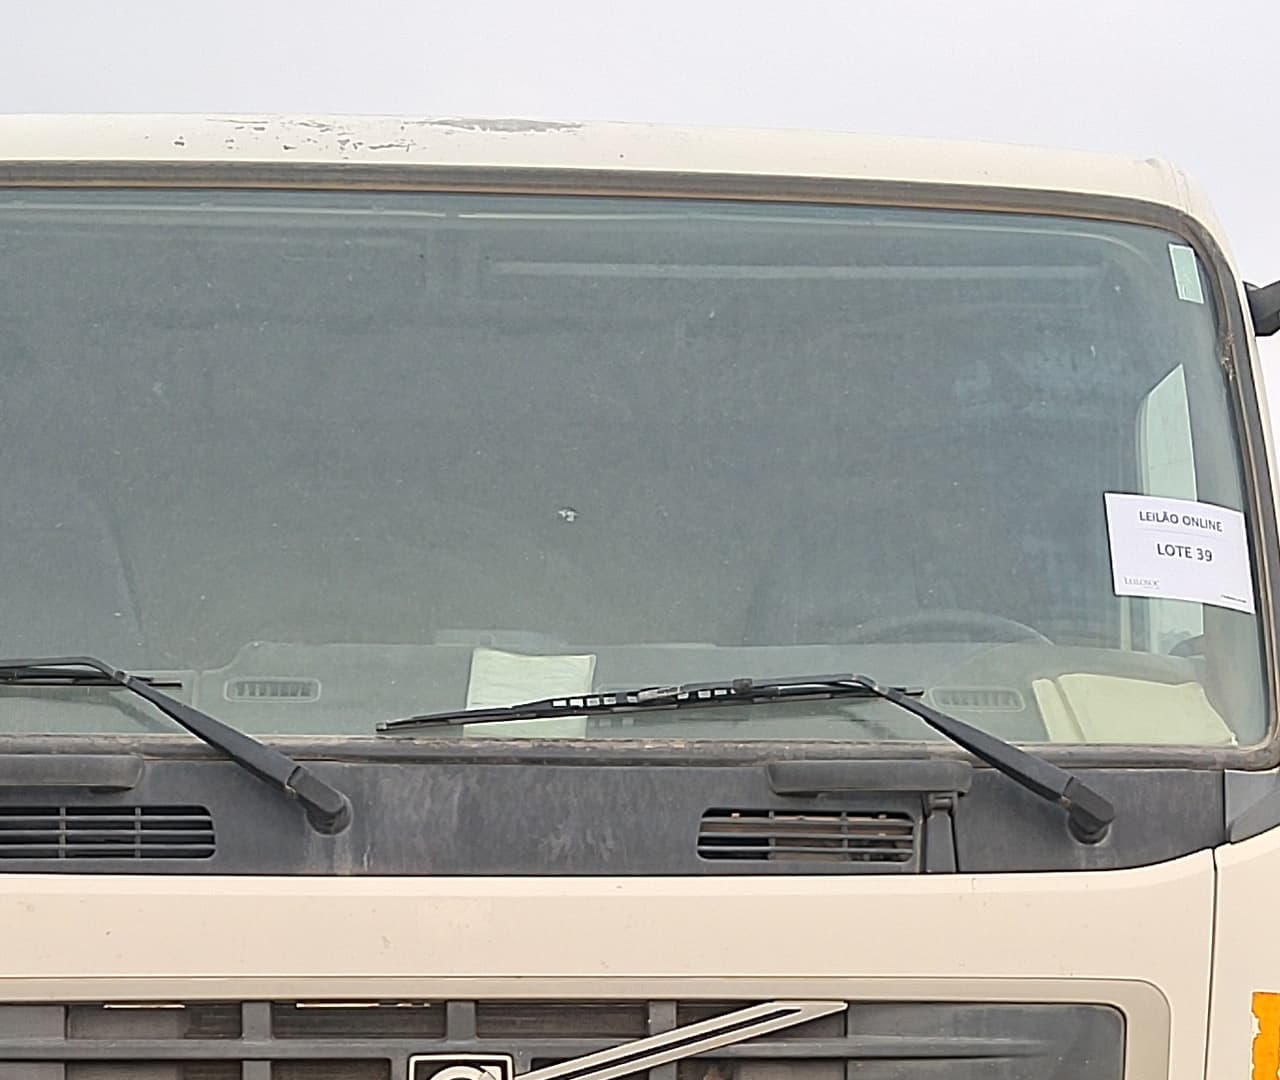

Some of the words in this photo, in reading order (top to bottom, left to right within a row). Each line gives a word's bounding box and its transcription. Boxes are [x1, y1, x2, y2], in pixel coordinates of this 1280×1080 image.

[1138, 510, 1179, 525] LEILÃO
[1182, 515, 1222, 532] ONLINE
[1156, 543, 1193, 559] LOTE
[1196, 547, 1213, 563] 39
